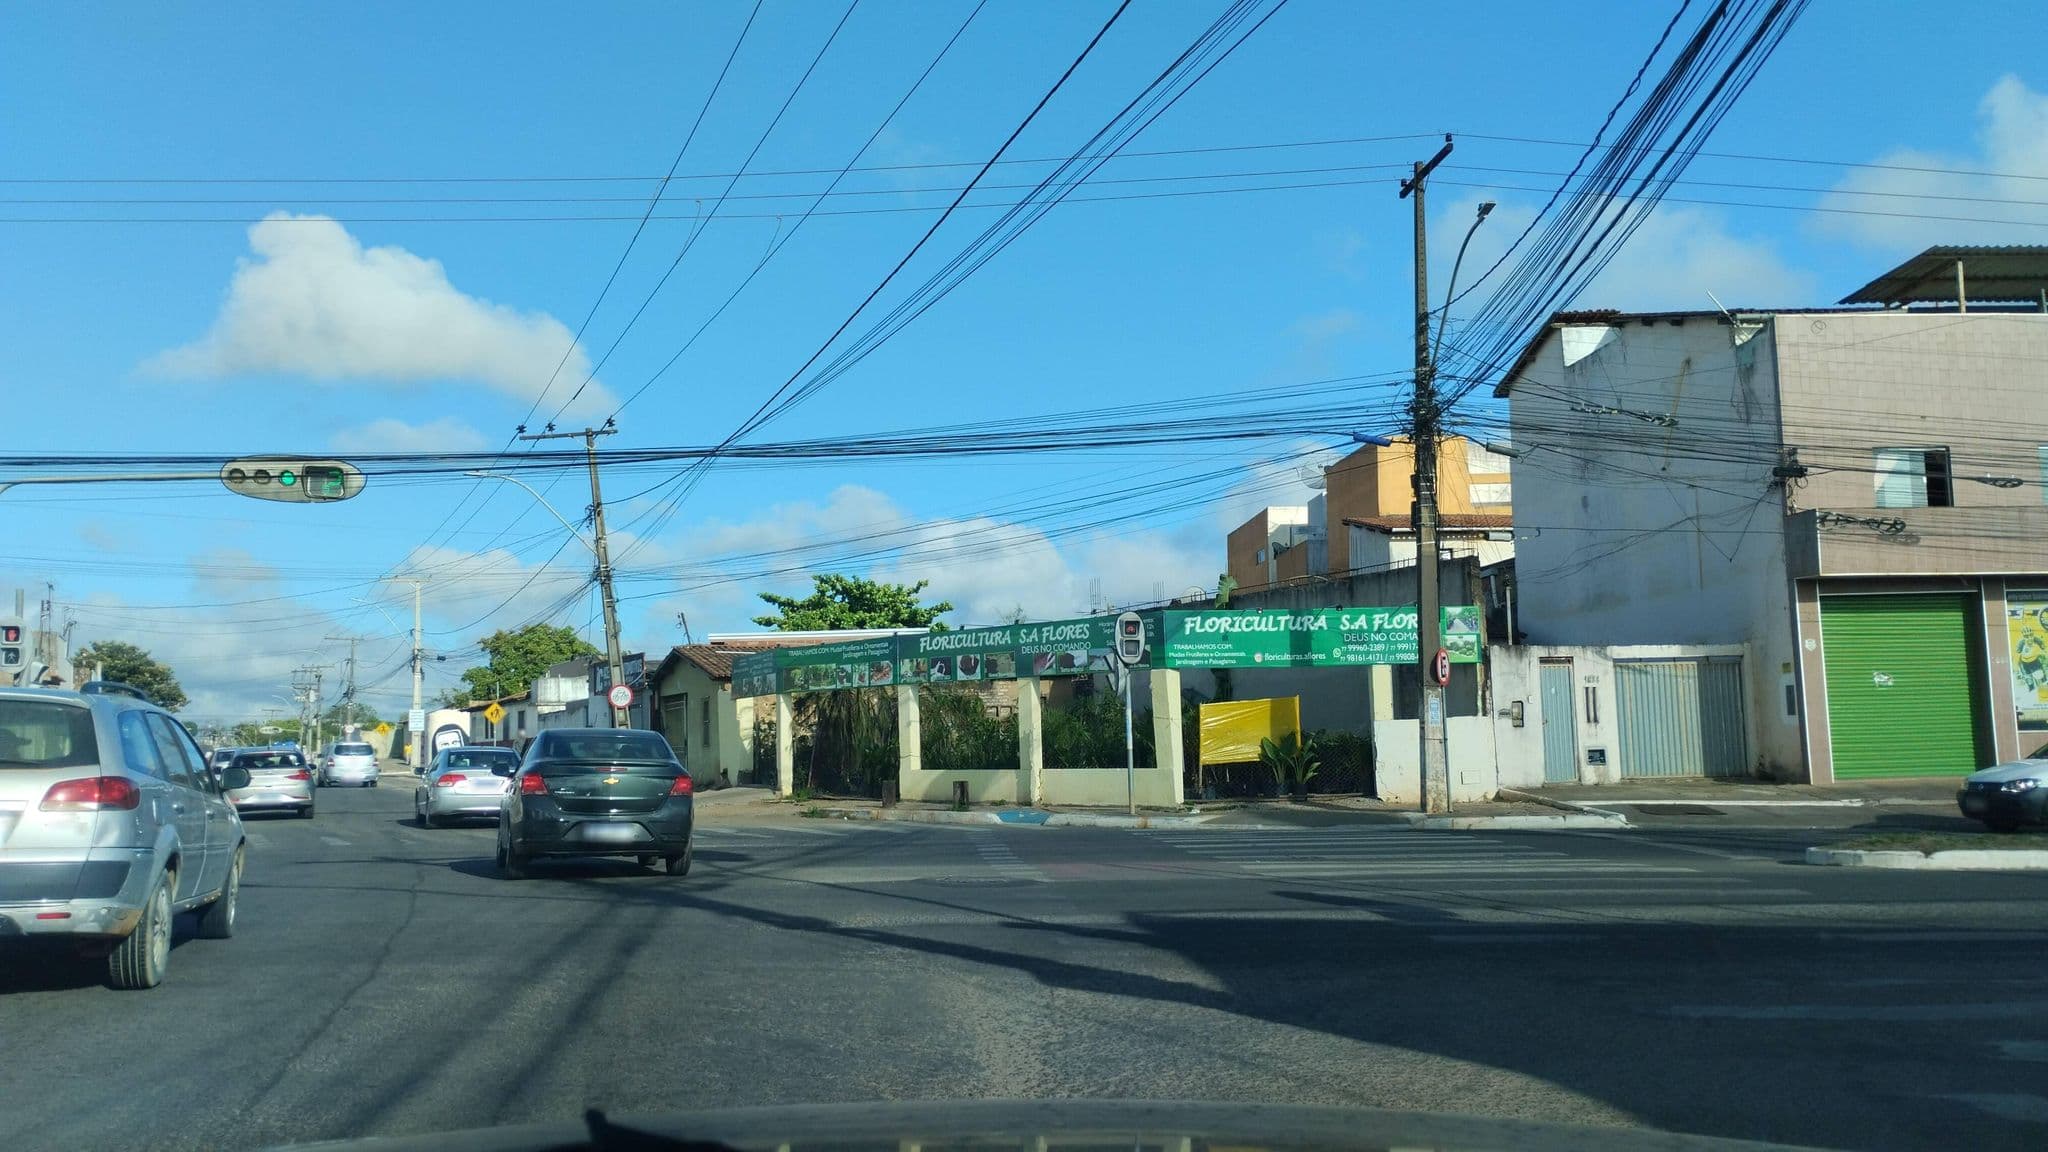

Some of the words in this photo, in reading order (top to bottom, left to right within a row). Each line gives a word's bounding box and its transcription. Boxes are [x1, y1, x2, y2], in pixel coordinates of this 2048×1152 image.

[1184, 615, 1328, 635] FLORICULTURA
[1340, 614, 1368, 630] S.A
[1373, 612, 1418, 631] FLOR
[919, 630, 1011, 653] FLORICULTURA
[1018, 627, 1039, 644] S.A
[1042, 623, 1090, 643] FLORES
[1344, 633, 1369, 642] DEUS
[1371, 633, 1387, 641] NO
[1389, 632, 1418, 641] COMA
[1021, 645, 1040, 654] DEUS
[1040, 644, 1051, 653] NO
[1052, 641, 1091, 652] COMANDO
[1347, 643, 1385, 652] 99960-2389
[1346, 653, 1384, 662] 98161-4171
